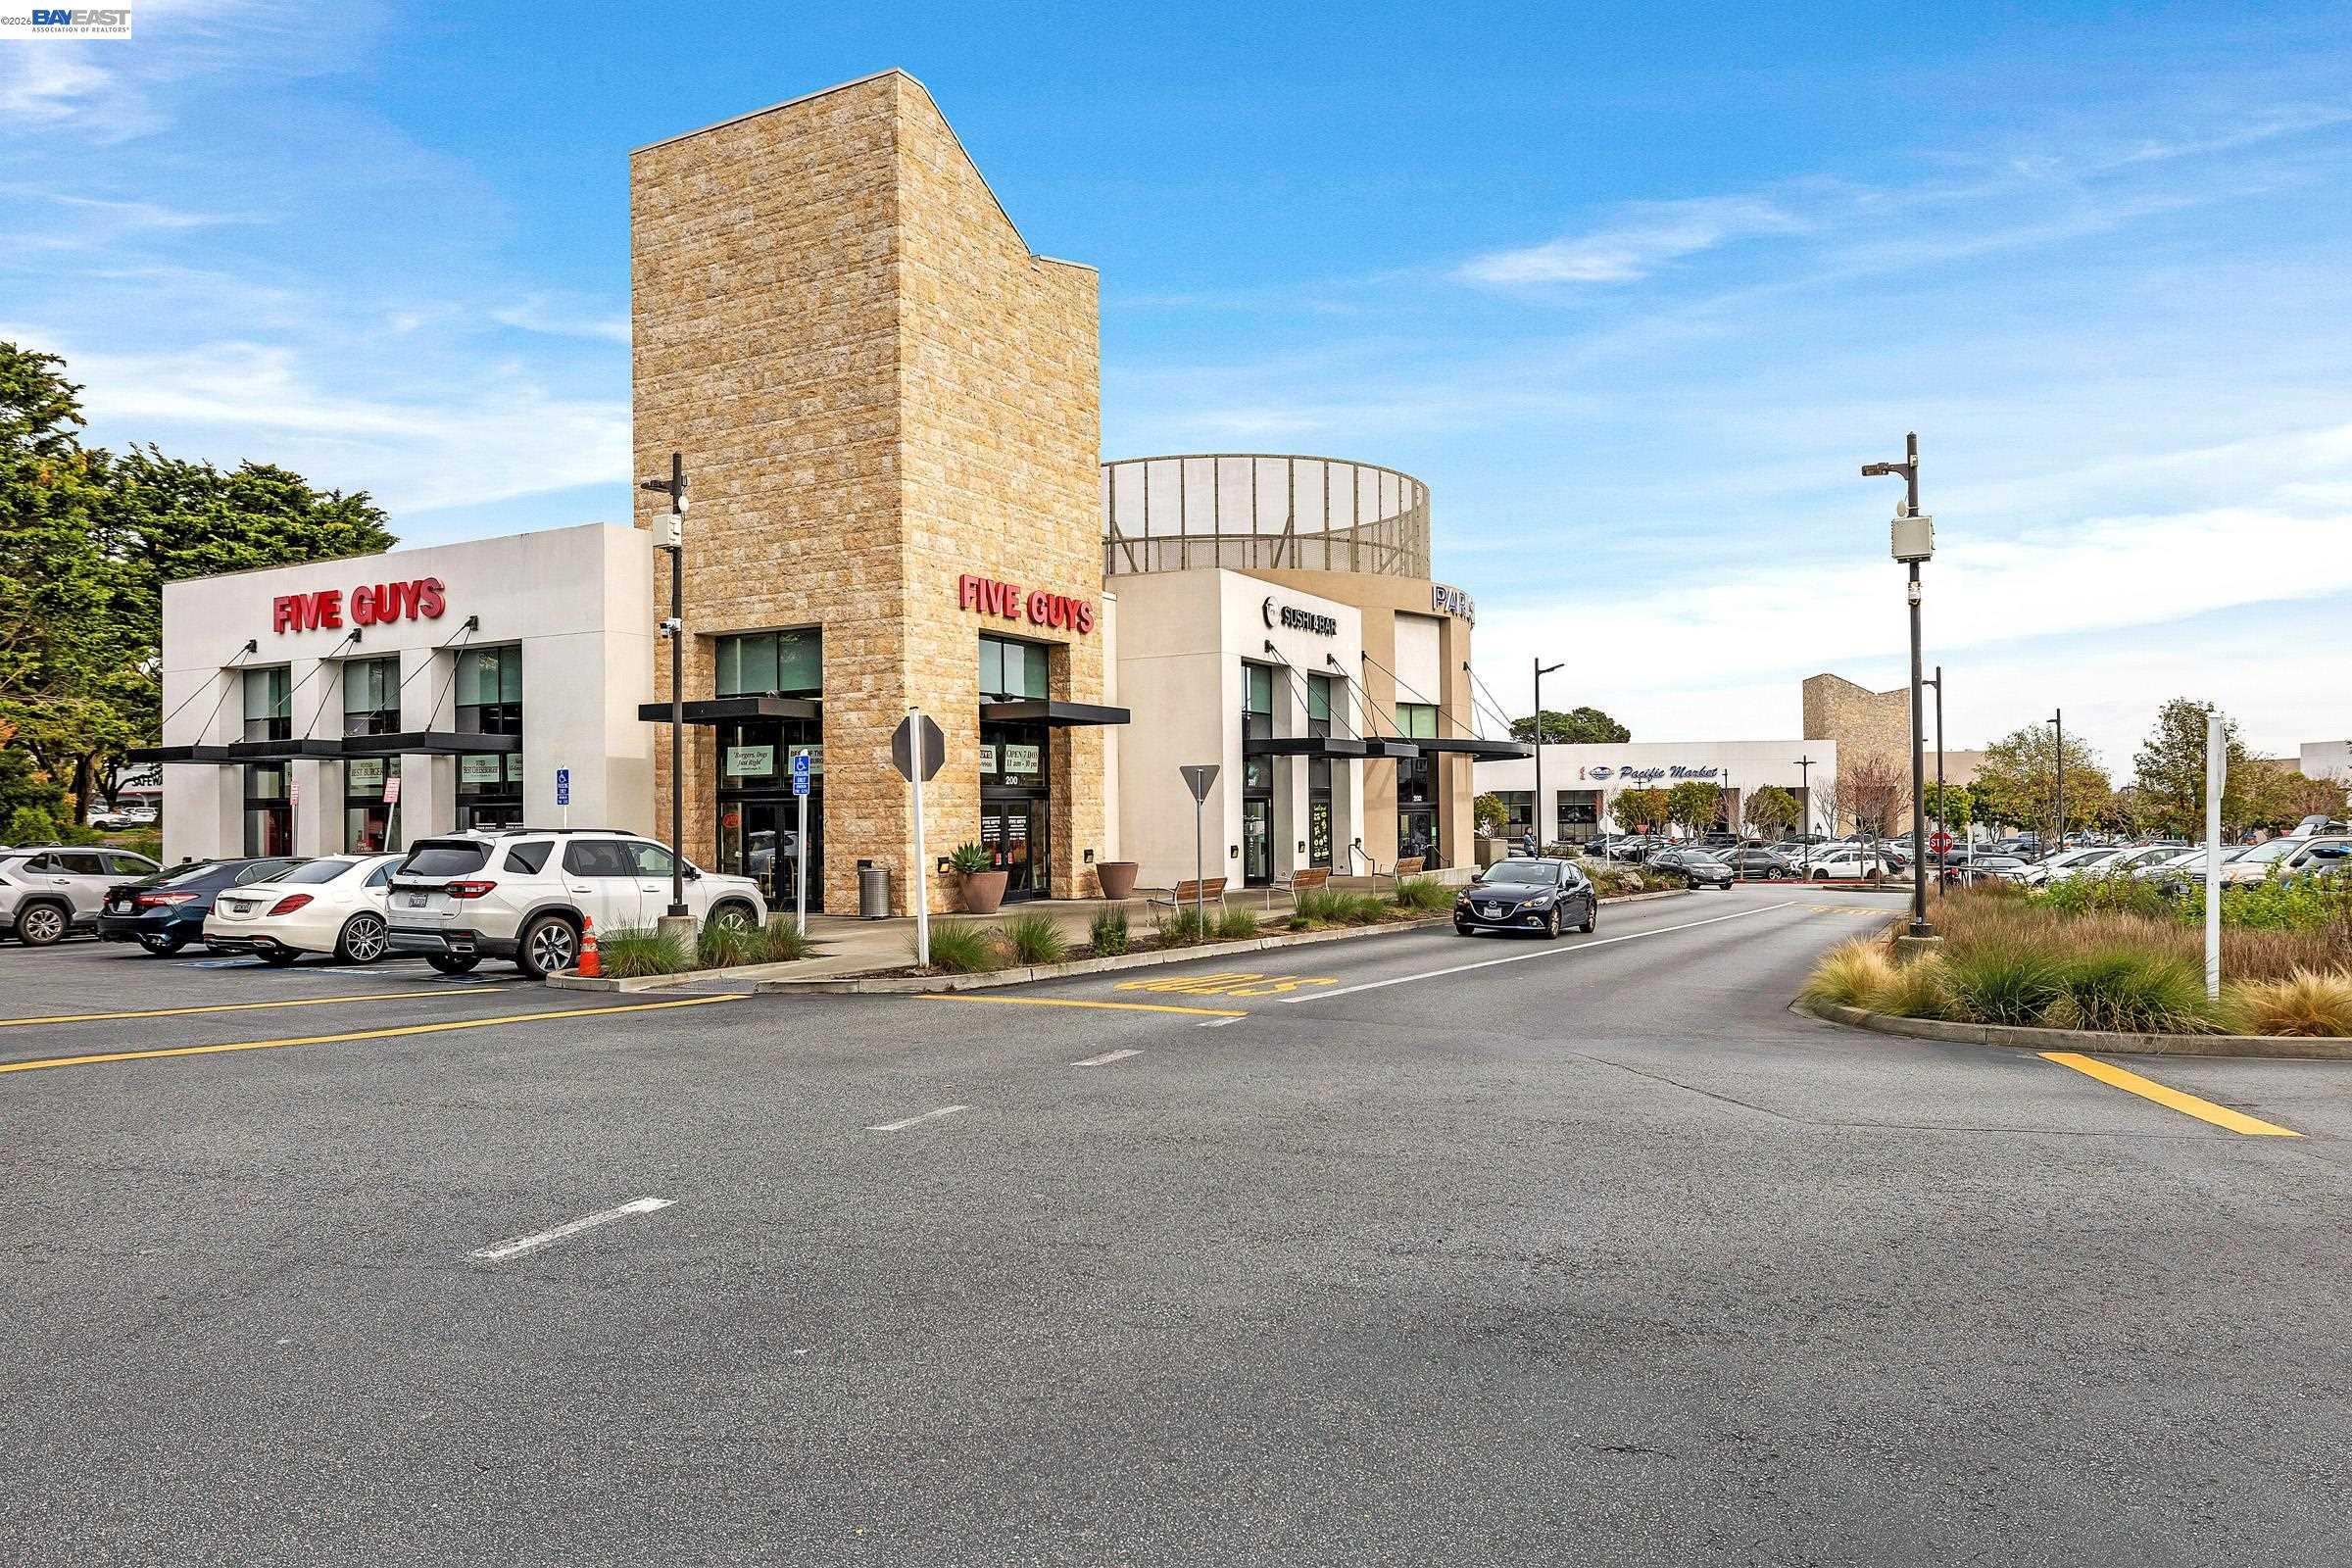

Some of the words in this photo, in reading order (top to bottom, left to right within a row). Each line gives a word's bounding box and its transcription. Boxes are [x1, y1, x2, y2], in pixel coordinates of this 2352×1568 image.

[273, 590, 343, 634] FIVE
[351, 576, 446, 626] GUYS
[959, 574, 1022, 620] FIVE
[1026, 590, 1095, 635] GUYS
[1281, 606, 1313, 632] SUSHI
[1006, 750, 1023, 759] OPEN
[1005, 775, 1018, 785] 200
[1619, 765, 1665, 782] Pacific
[1670, 765, 1718, 779] Market
[1930, 838, 1952, 848] STOP
